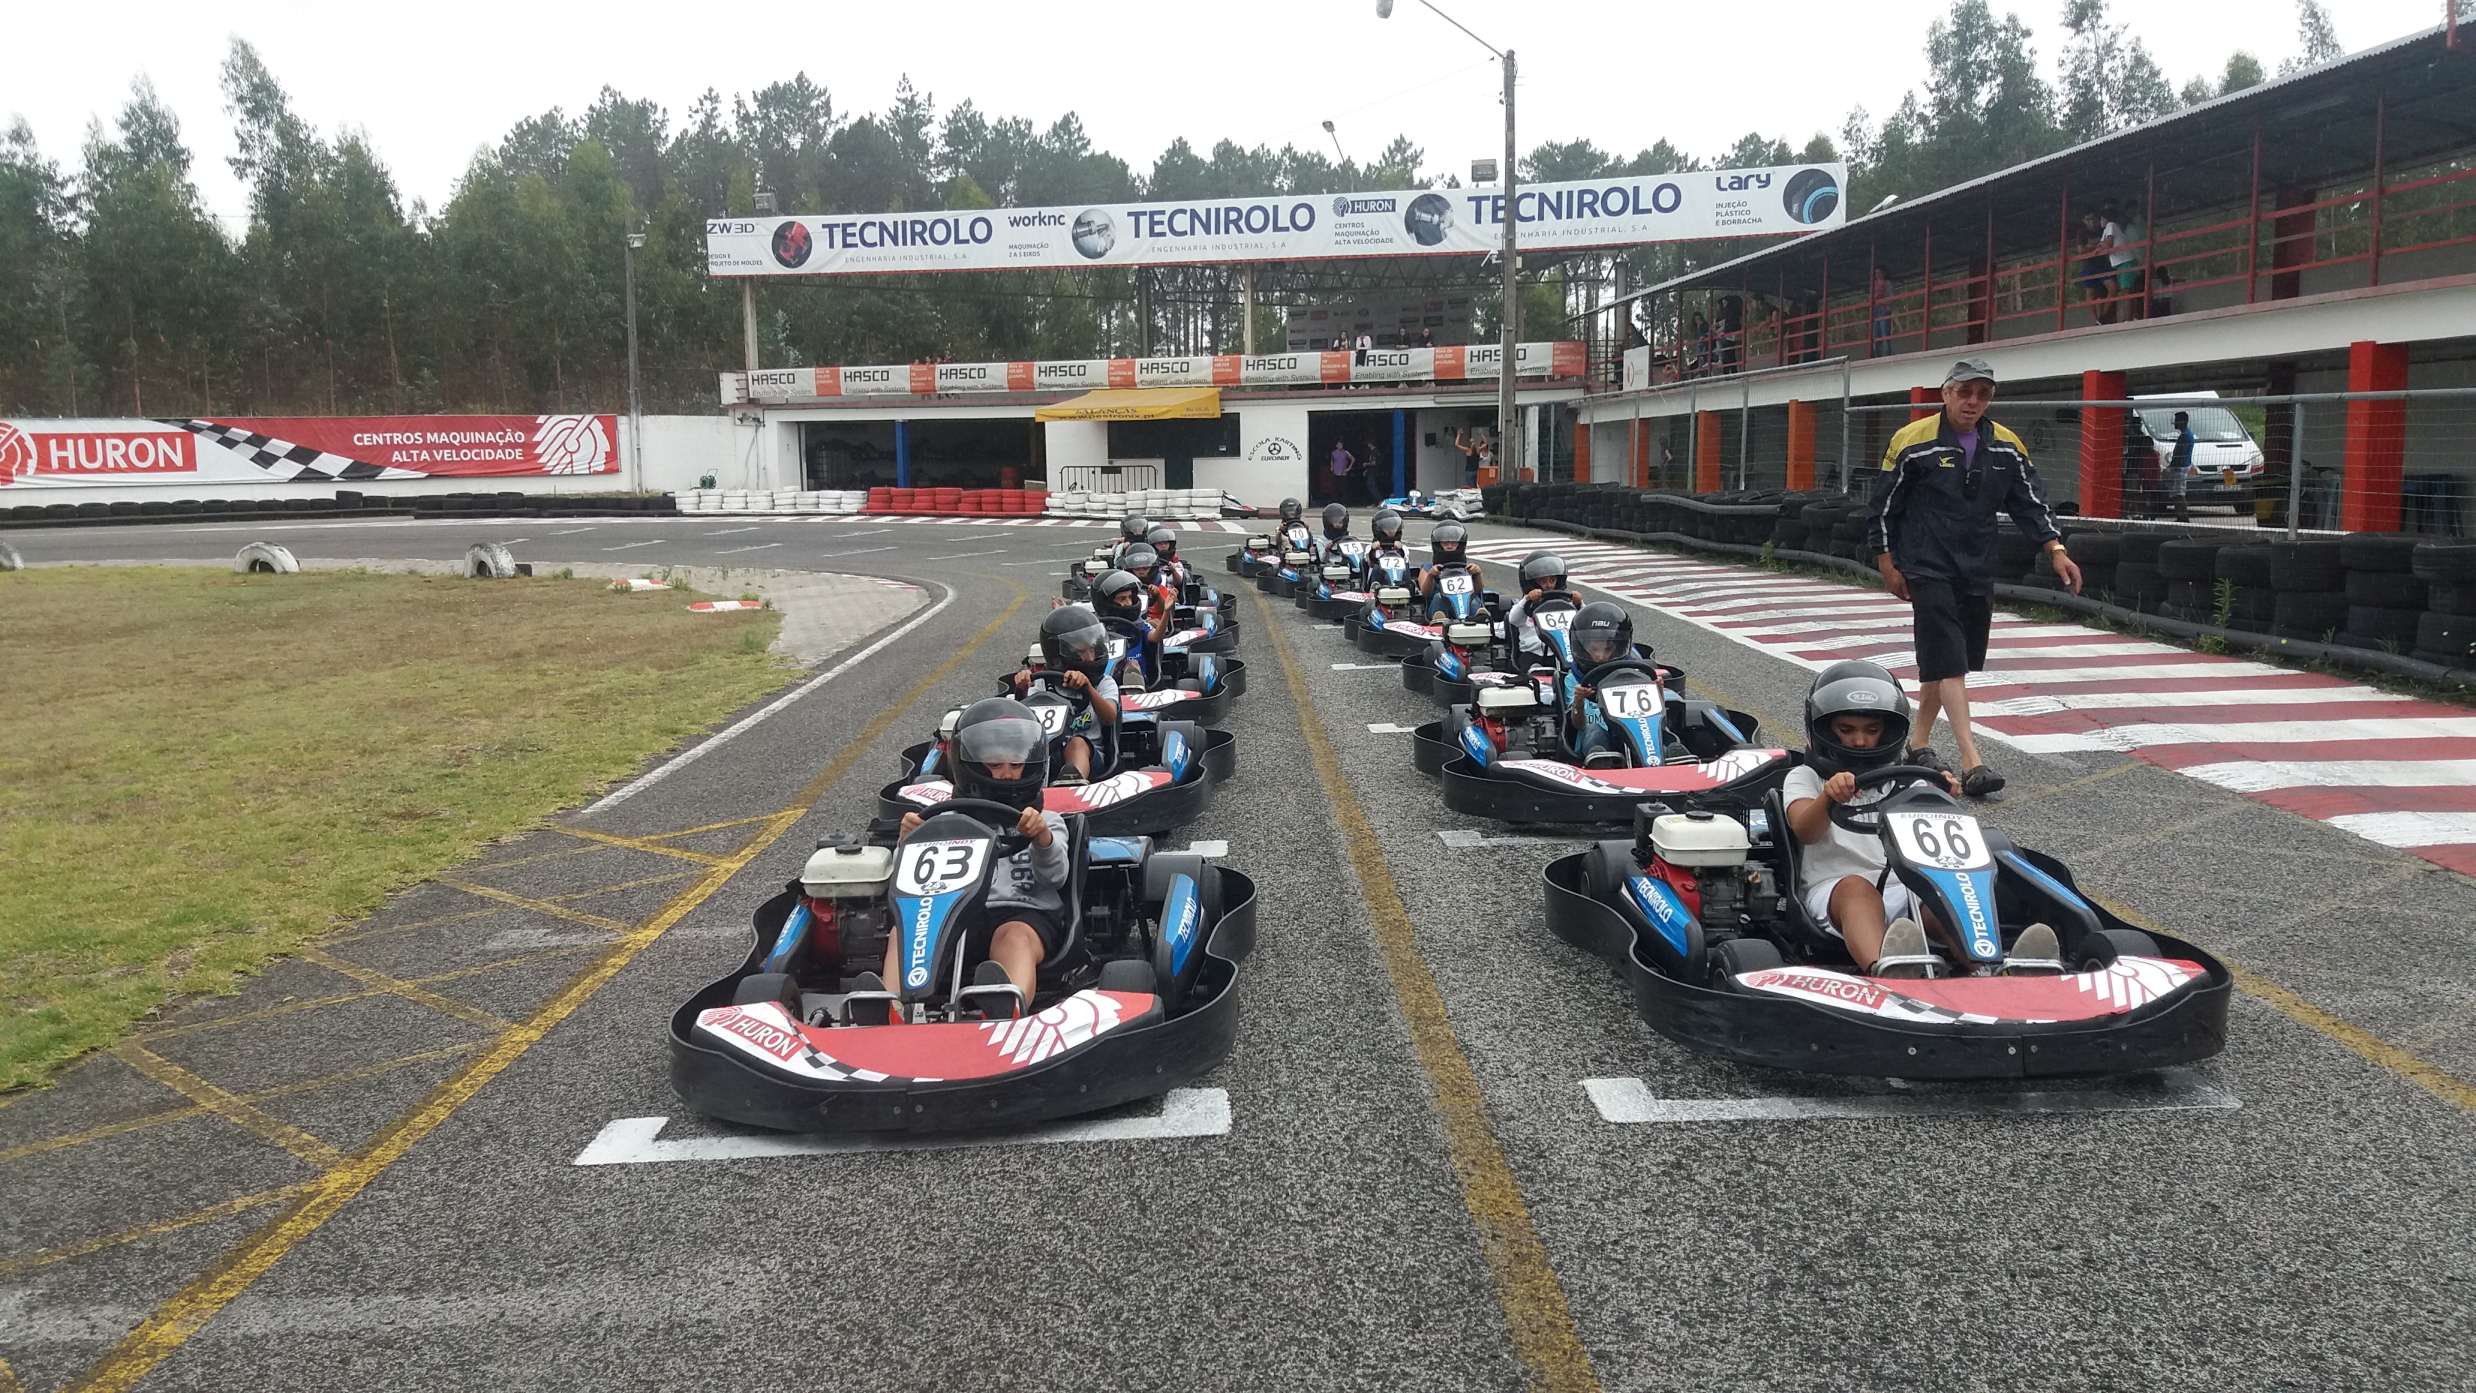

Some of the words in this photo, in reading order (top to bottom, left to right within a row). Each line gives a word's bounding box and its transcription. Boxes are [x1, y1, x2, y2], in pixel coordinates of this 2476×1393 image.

[1355, 200, 1393, 213] HURON
[1467, 183, 1682, 225] TECNIROLO
[1715, 200, 1748, 209] INJEÇÃO
[1008, 210, 1066, 227] worknc
[1127, 202, 1316, 239] TECNIROLO
[1715, 209, 1751, 218] PLÁSTICO
[1335, 222, 1365, 230] CENTROS
[1722, 218, 1762, 226] BORRACHA
[822, 216, 993, 250] TECNIROLO
[1335, 230, 1380, 238] MAQUINAÇÃO
[1152, 245, 1207, 253] ENGENHARIA
[1353, 238, 1394, 246] VELOCIDADE
[845, 255, 896, 263] ENGENHARIA
[1356, 353, 1409, 368] ASCO
[1470, 347, 1527, 362] HASO
[1038, 365, 1086, 378] HASCO
[1139, 361, 1190, 375] HASCO
[1246, 358, 1297, 372] HASCO
[751, 373, 796, 386] HASCO
[844, 370, 890, 383] HASCO
[939, 367, 987, 380] HASCO
[1355, 371, 1385, 380] Enabling
[352, 432, 424, 446] CENTROS
[426, 428, 525, 447] MAQUINAÇÃO
[49, 437, 184, 470] HURON
[391, 450, 431, 463] ALTA
[432, 448, 524, 461] VELOCIDADE
[1247, 438, 1271, 461] ESCOLA
[1275, 437, 1303, 461] KARTING
[1384, 558, 1402, 569] 72
[1446, 577, 1465, 593] 62
[1544, 612, 1569, 629] 64
[1591, 620, 1611, 628] nau
[1612, 689, 1652, 713] 76
[1913, 817, 1971, 860] 66
[914, 846, 974, 885] 63
[1637, 877, 1674, 923] TECNIROLO
[1956, 872, 1989, 939] TECNIROLO
[912, 897, 934, 968] TECNIROLO
[1791, 976, 1880, 1005] HURON
[731, 1018, 798, 1057] HURON
